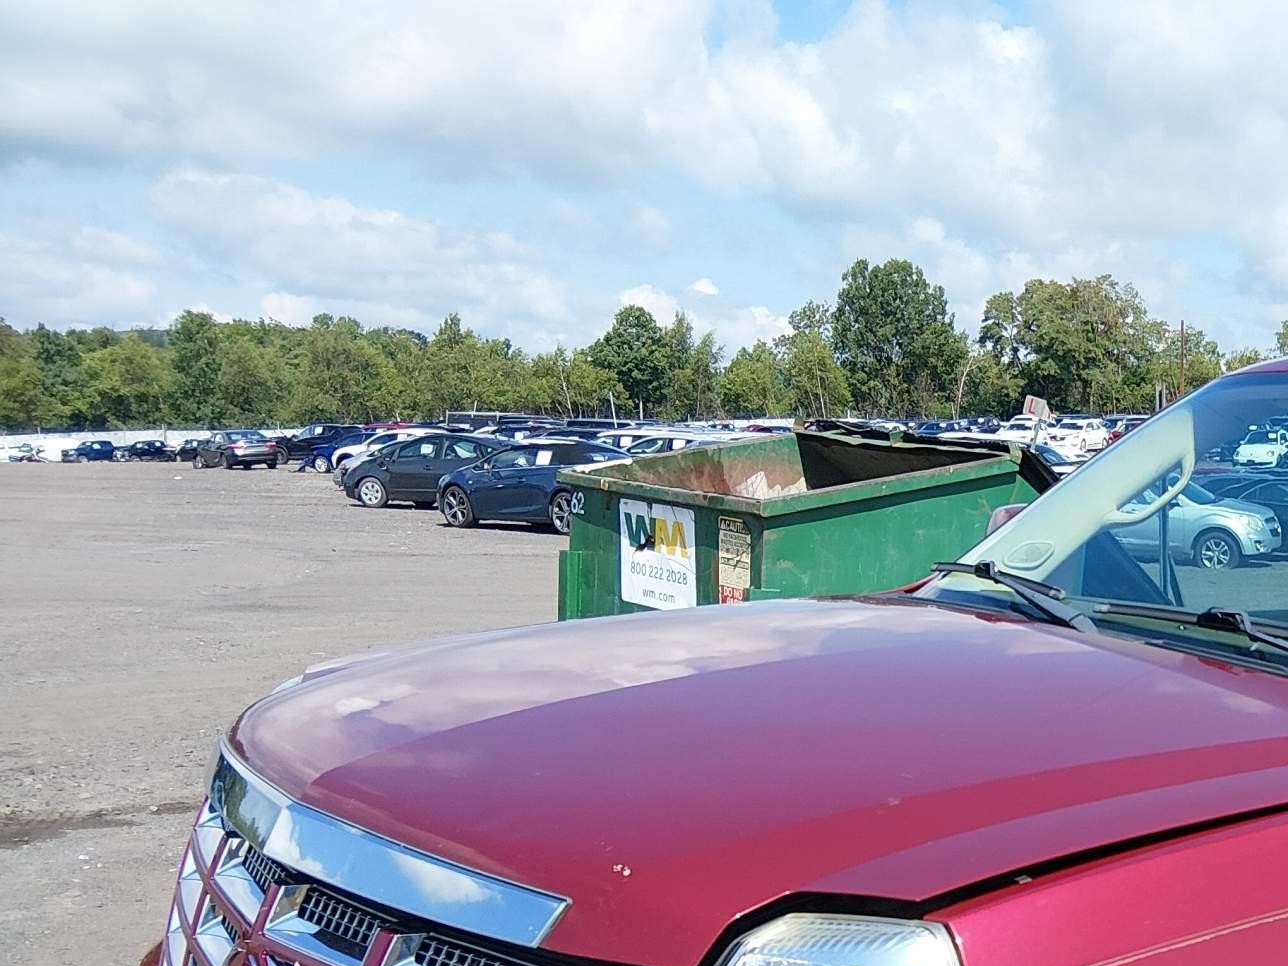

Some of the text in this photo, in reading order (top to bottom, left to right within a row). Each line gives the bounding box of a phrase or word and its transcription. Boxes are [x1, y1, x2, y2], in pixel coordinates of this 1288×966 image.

[570, 491, 585, 515] 62
[624, 512, 690, 560] WM
[630, 561, 688, 585] 800 222 2028
[642, 588, 676, 604] wm.com
[723, 586, 733, 598] DO
[733, 588, 744, 601] NO
